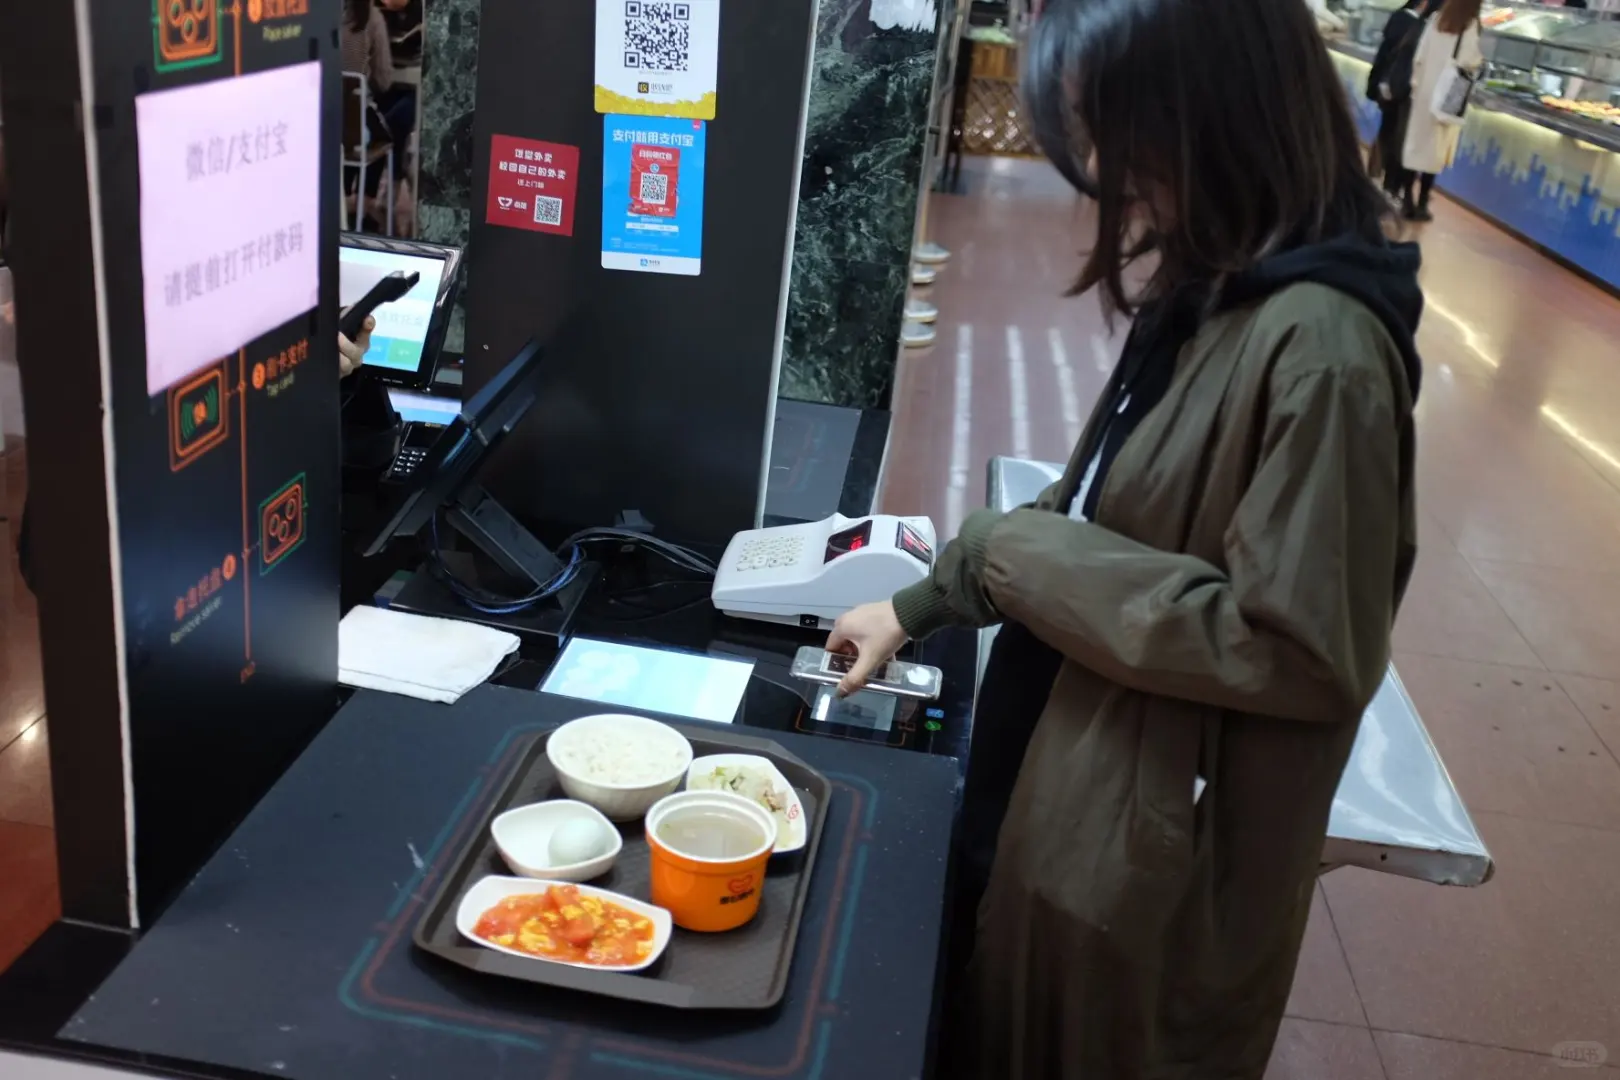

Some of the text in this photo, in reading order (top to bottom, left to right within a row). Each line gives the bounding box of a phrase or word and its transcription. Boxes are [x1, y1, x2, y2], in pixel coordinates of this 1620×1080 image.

[186, 119, 288, 181] 微信/支付宝
[613, 129, 694, 147] 支付就用支付宝
[164, 221, 304, 307] 请提前打开付款码
